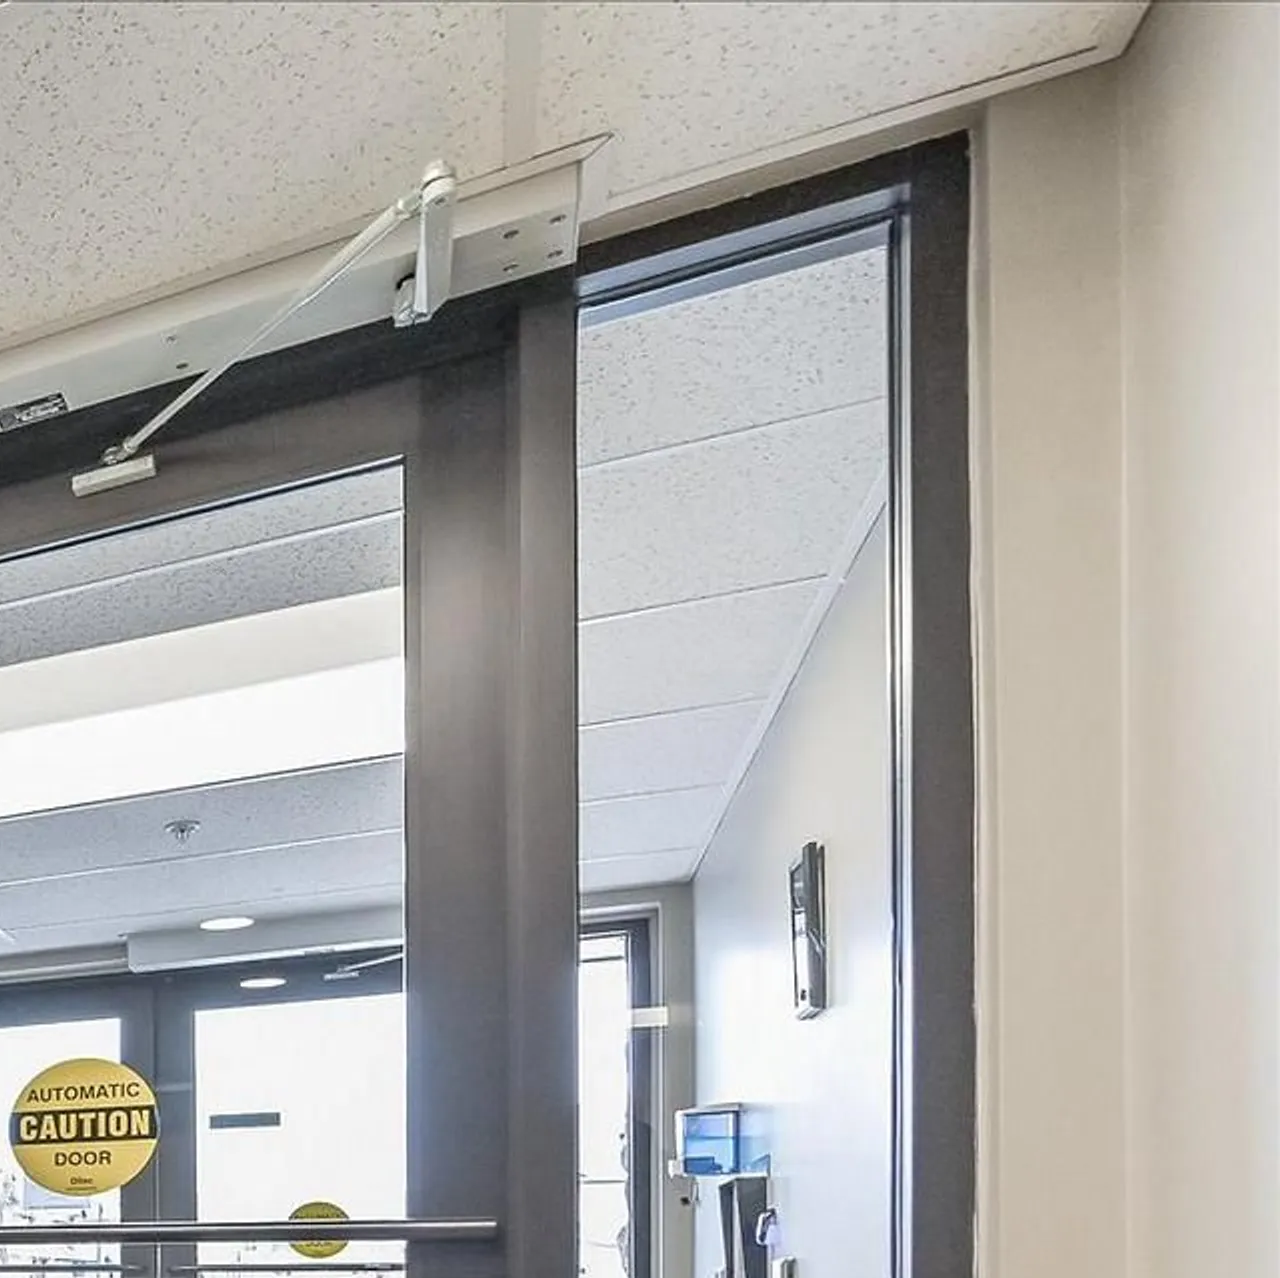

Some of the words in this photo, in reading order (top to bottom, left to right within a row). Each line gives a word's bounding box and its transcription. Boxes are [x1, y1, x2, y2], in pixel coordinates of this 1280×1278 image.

[26, 1082, 140, 1103] AUTOMATIC
[19, 1109, 150, 1141] CAUTION
[54, 1150, 112, 1167] DOOR
